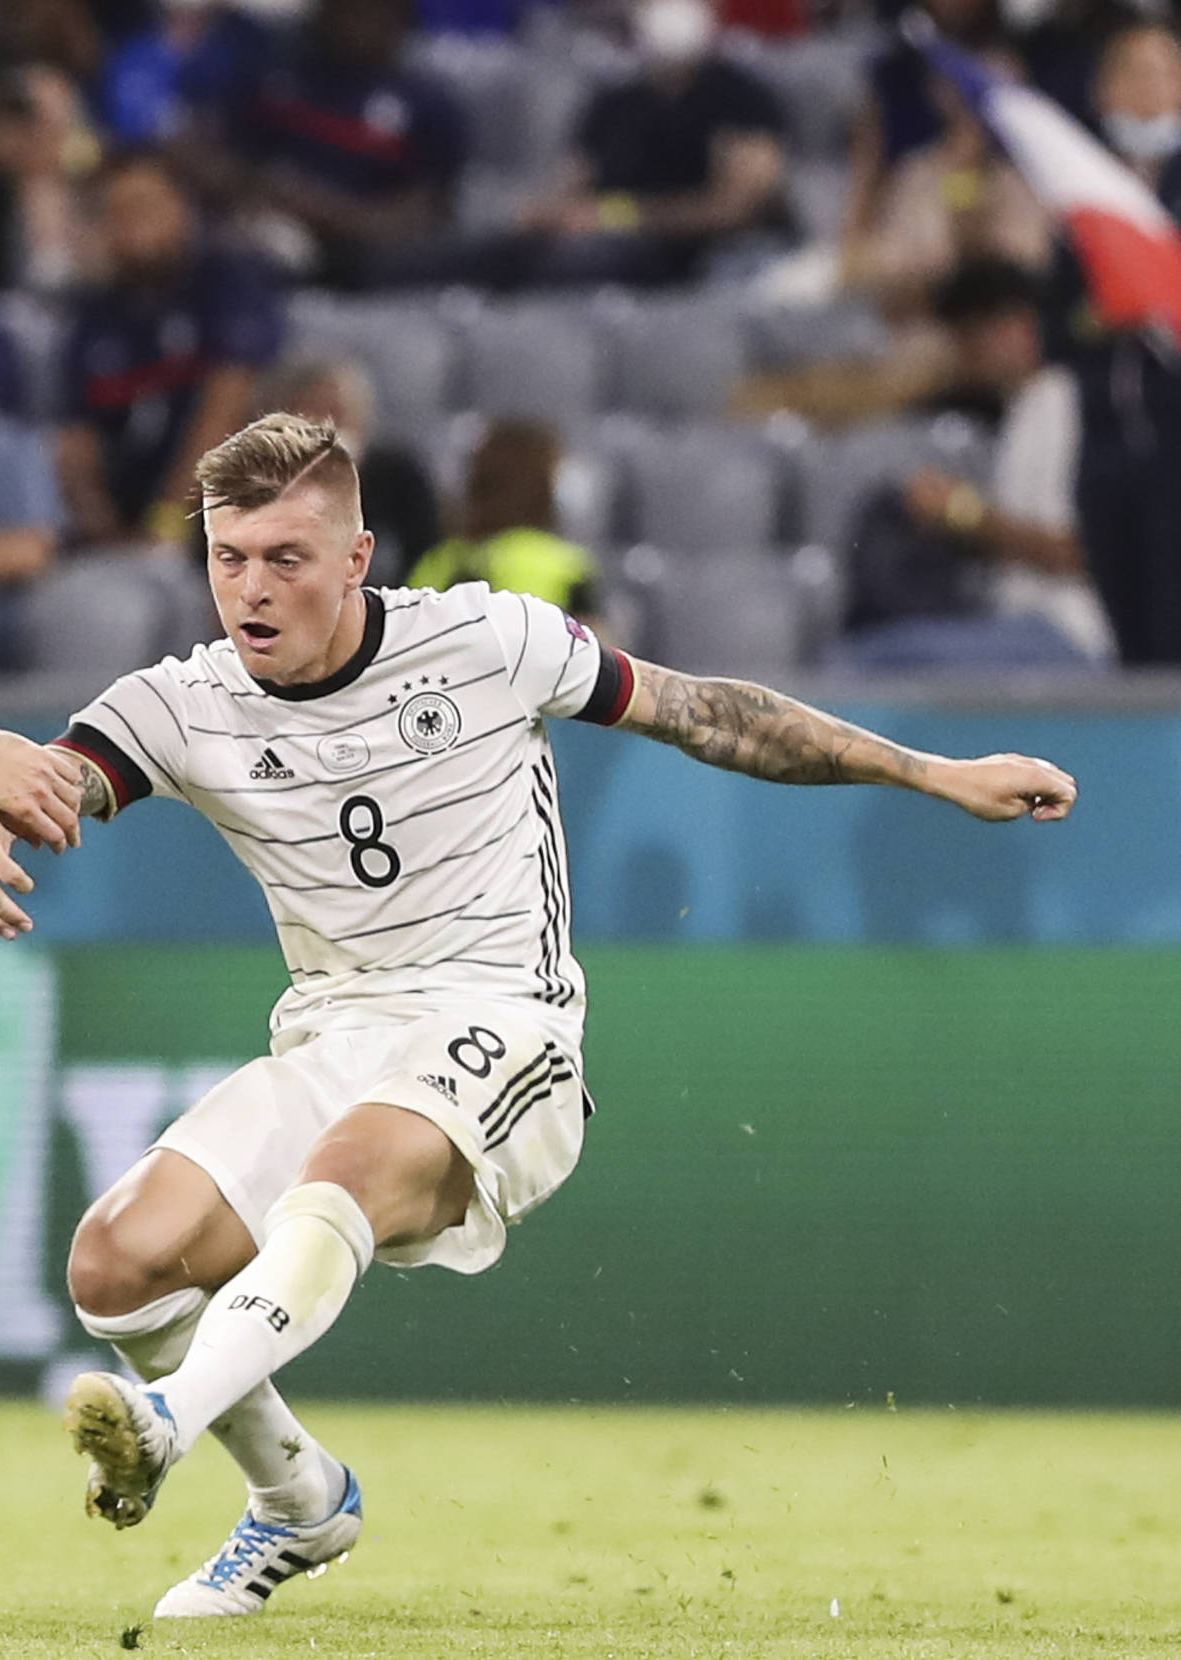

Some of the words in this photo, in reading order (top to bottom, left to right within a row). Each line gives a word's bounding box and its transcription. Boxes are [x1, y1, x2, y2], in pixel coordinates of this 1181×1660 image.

[340, 795, 401, 888] 8
[448, 1026, 507, 1079] 8
[227, 1294, 290, 1334] DFB
